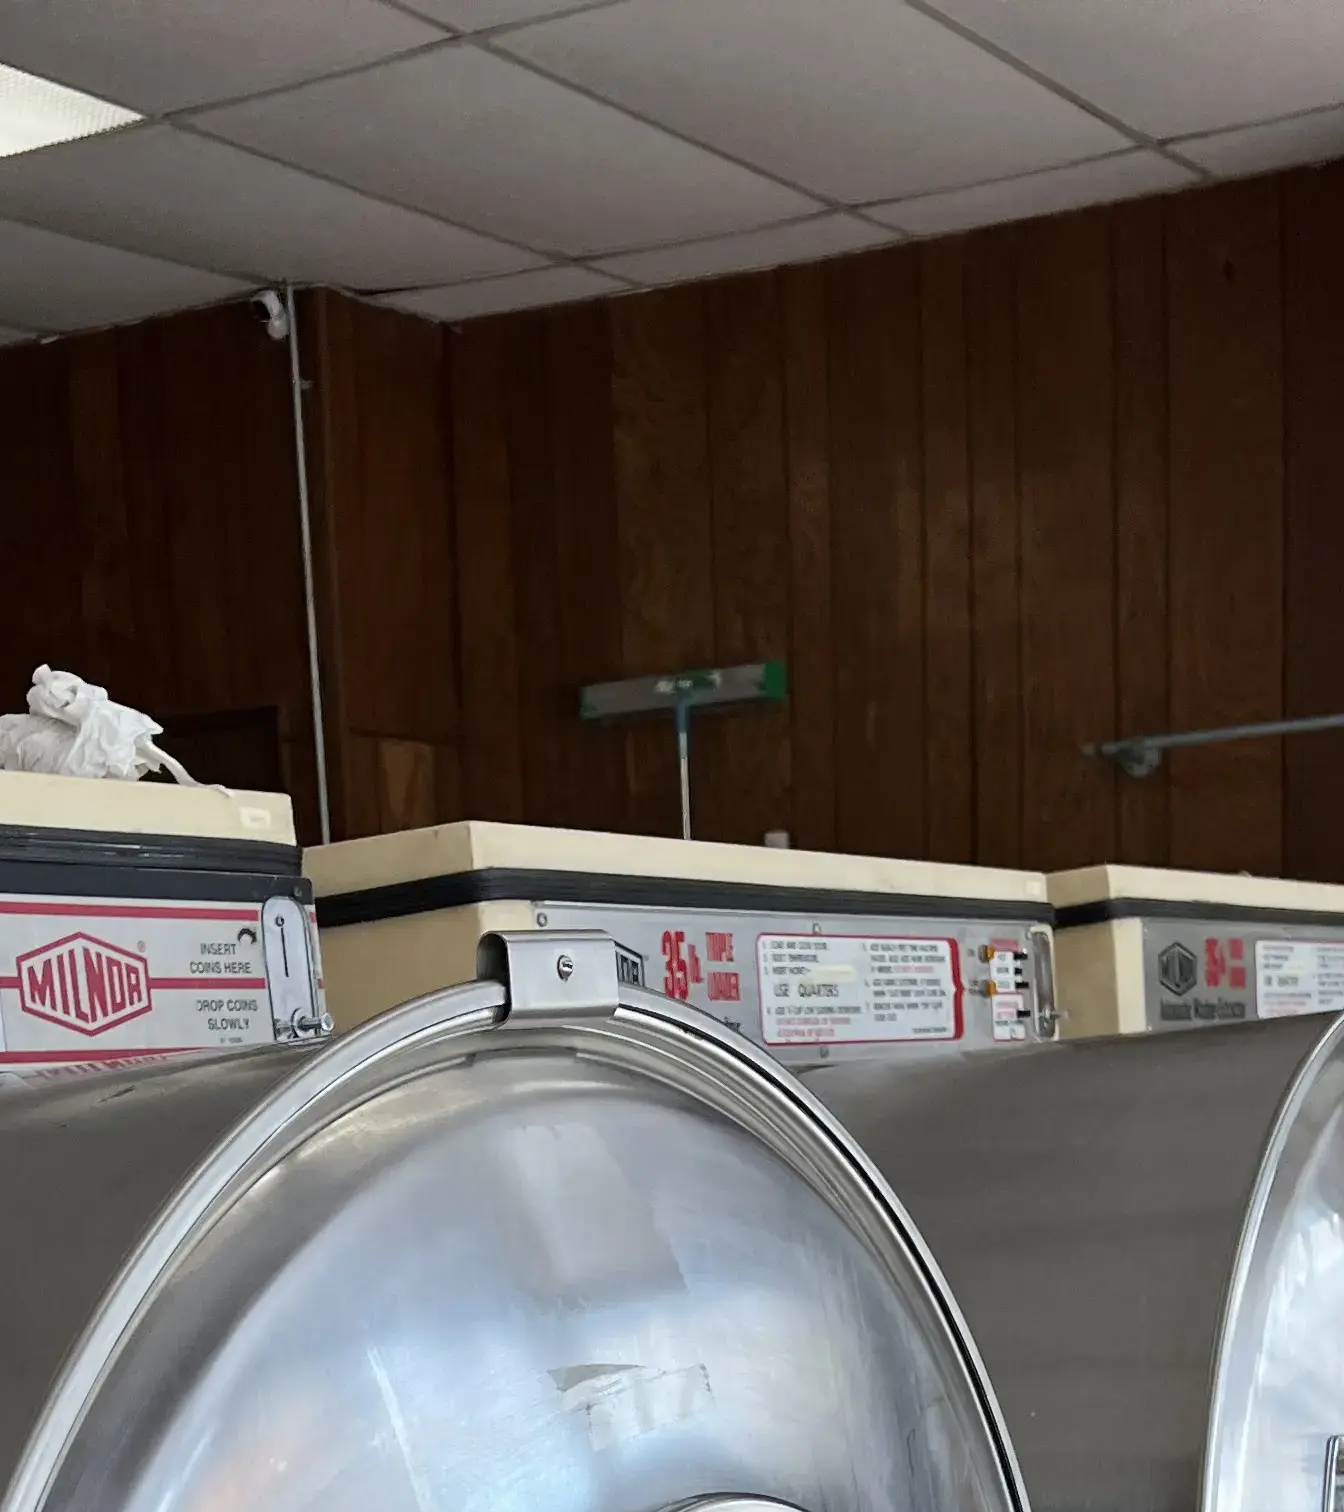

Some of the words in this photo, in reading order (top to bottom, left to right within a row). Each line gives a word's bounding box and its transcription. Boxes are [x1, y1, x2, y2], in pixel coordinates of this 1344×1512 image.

[200, 943, 237, 955] INSERT
[190, 961, 222, 974] COINS
[224, 962, 252, 974] HERE
[27, 945, 143, 1024] MILNOR
[196, 999, 224, 1012] DROP
[227, 999, 258, 1012] COINS
[207, 1017, 249, 1031] SLOWLY
